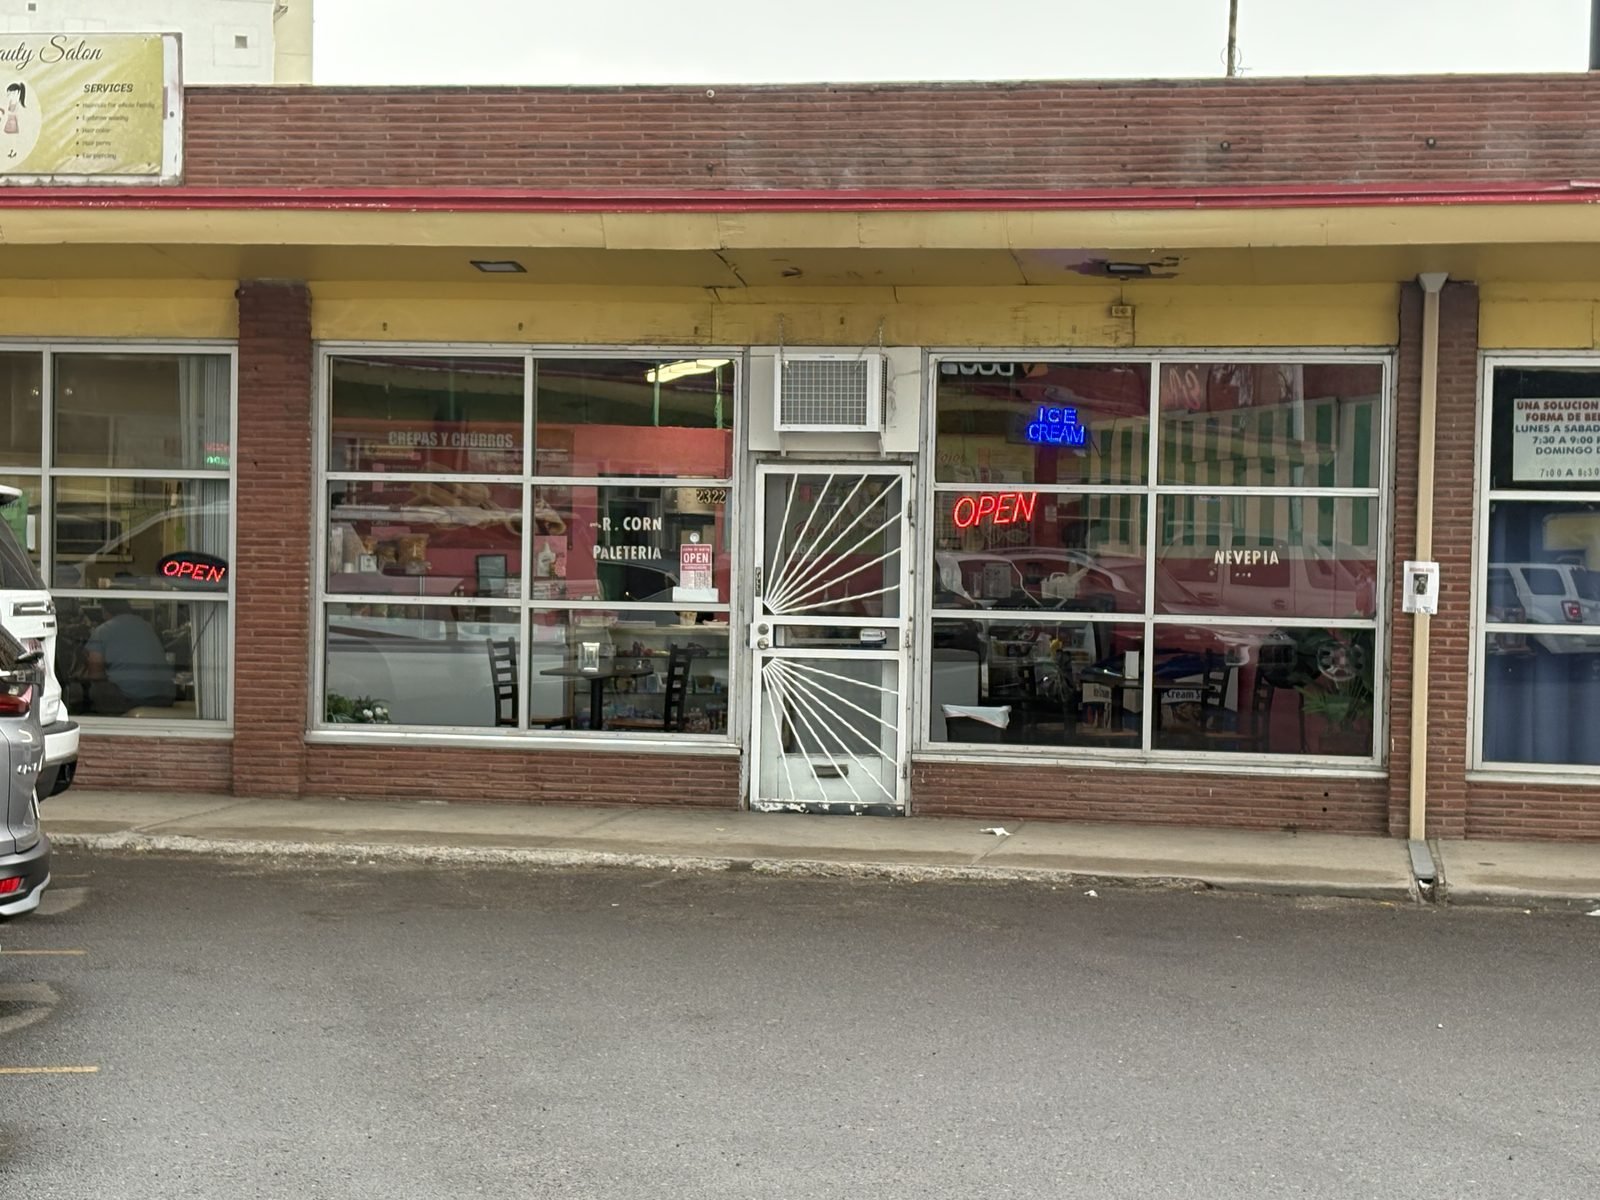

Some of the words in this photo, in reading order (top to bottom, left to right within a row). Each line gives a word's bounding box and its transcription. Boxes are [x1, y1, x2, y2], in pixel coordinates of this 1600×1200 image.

[39, 34, 103, 64] Salon
[84, 84, 134, 93] SERVICES
[1517, 401, 1539, 410] UNA
[1544, 401, 1598, 410] SOLUCION
[1039, 407, 1076, 424] ICE
[1526, 412, 1563, 421] FORMA
[1568, 413, 1581, 421] DE
[1028, 424, 1085, 443] CREAM
[1515, 424, 1550, 433] LUNES
[388, 431, 438, 446] CREPAS
[441, 433, 449, 446] Y
[1533, 436, 1555, 444] 7:30
[1558, 436, 1566, 444] A
[1570, 436, 1593, 444] 9:00
[1536, 447, 1593, 455] DOMINGO
[1566, 468, 1574, 477] A
[696, 489, 727, 504] 2322
[954, 492, 1037, 527] OPEN
[623, 517, 662, 531] CORN
[593, 545, 662, 560] PALETERIA
[683, 552, 709, 563] OPEN
[163, 560, 226, 583] OPEN
